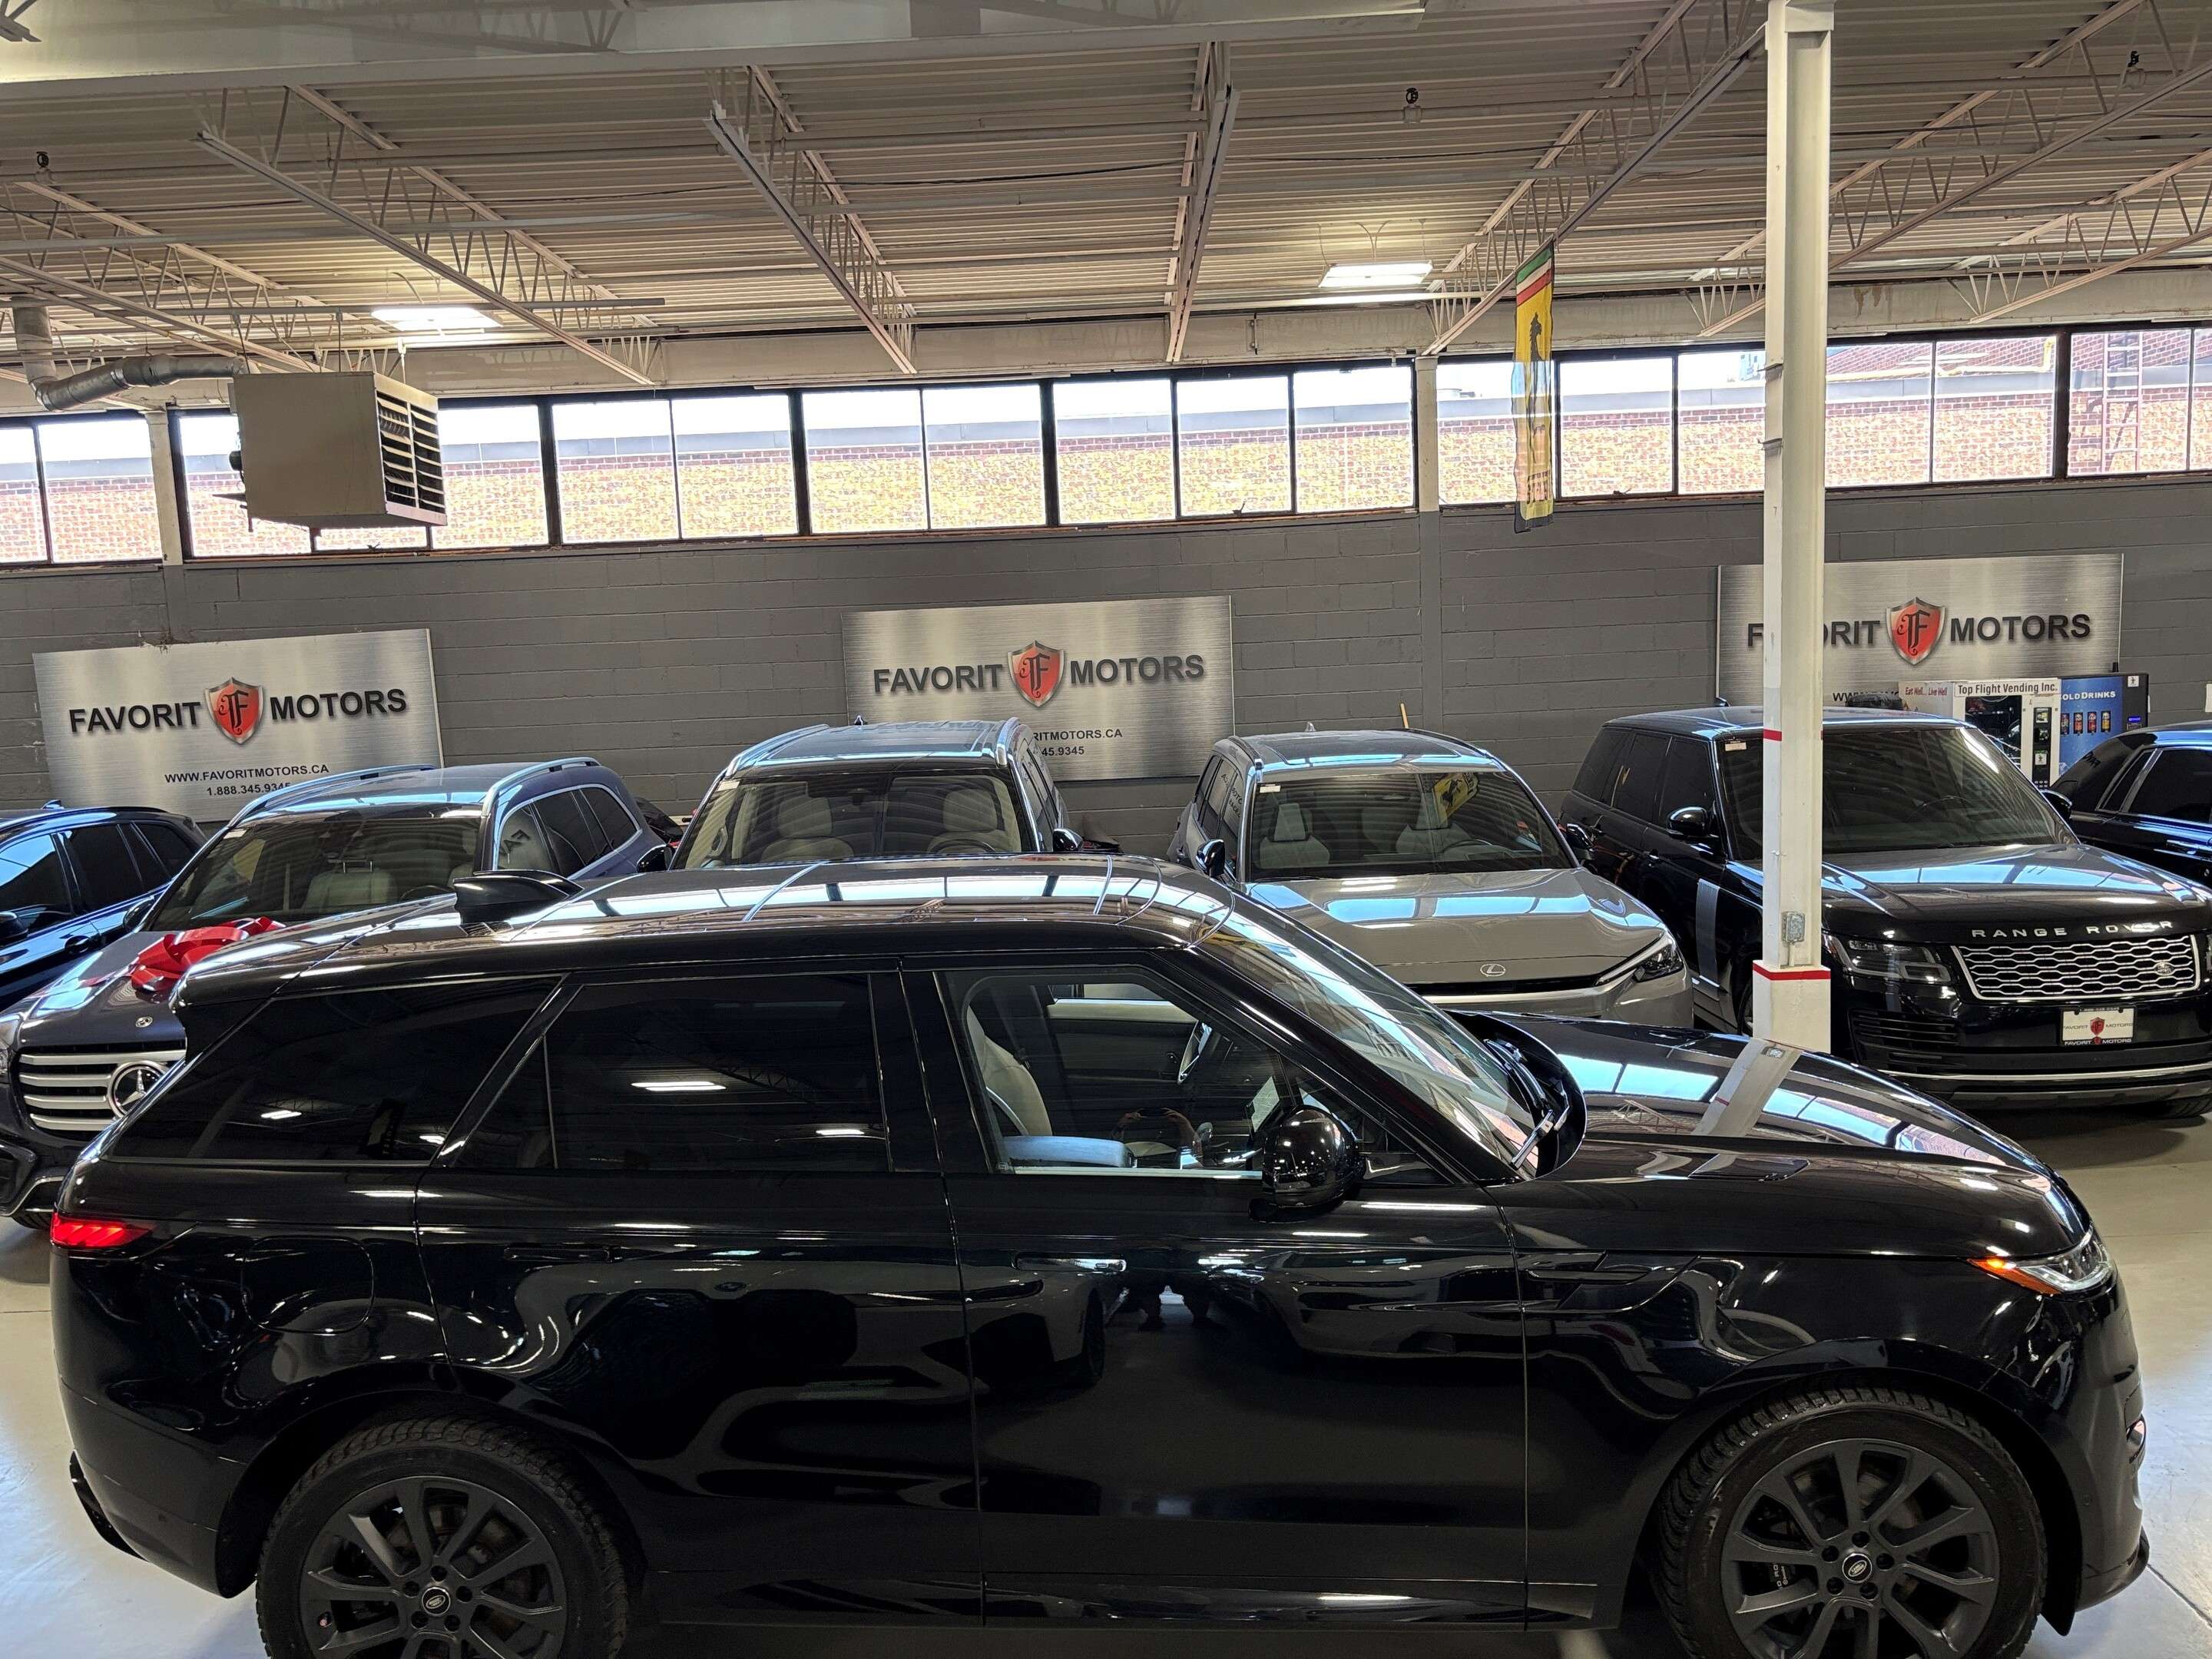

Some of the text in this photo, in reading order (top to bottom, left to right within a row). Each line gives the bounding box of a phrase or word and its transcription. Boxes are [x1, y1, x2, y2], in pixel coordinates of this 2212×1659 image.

[1950, 614, 2091, 642] MOTORS
[873, 664, 1003, 692] FAVORIT
[1070, 654, 1204, 684] MOTORS
[1959, 682, 2058, 695] Top Flight Vending Inc.
[69, 701, 200, 732] FAVORIT
[270, 690, 406, 720] MOTORS
[164, 764, 329, 783] WWW.FAVORITMOTORS.CA
[1972, 927, 2068, 938] RANGE
